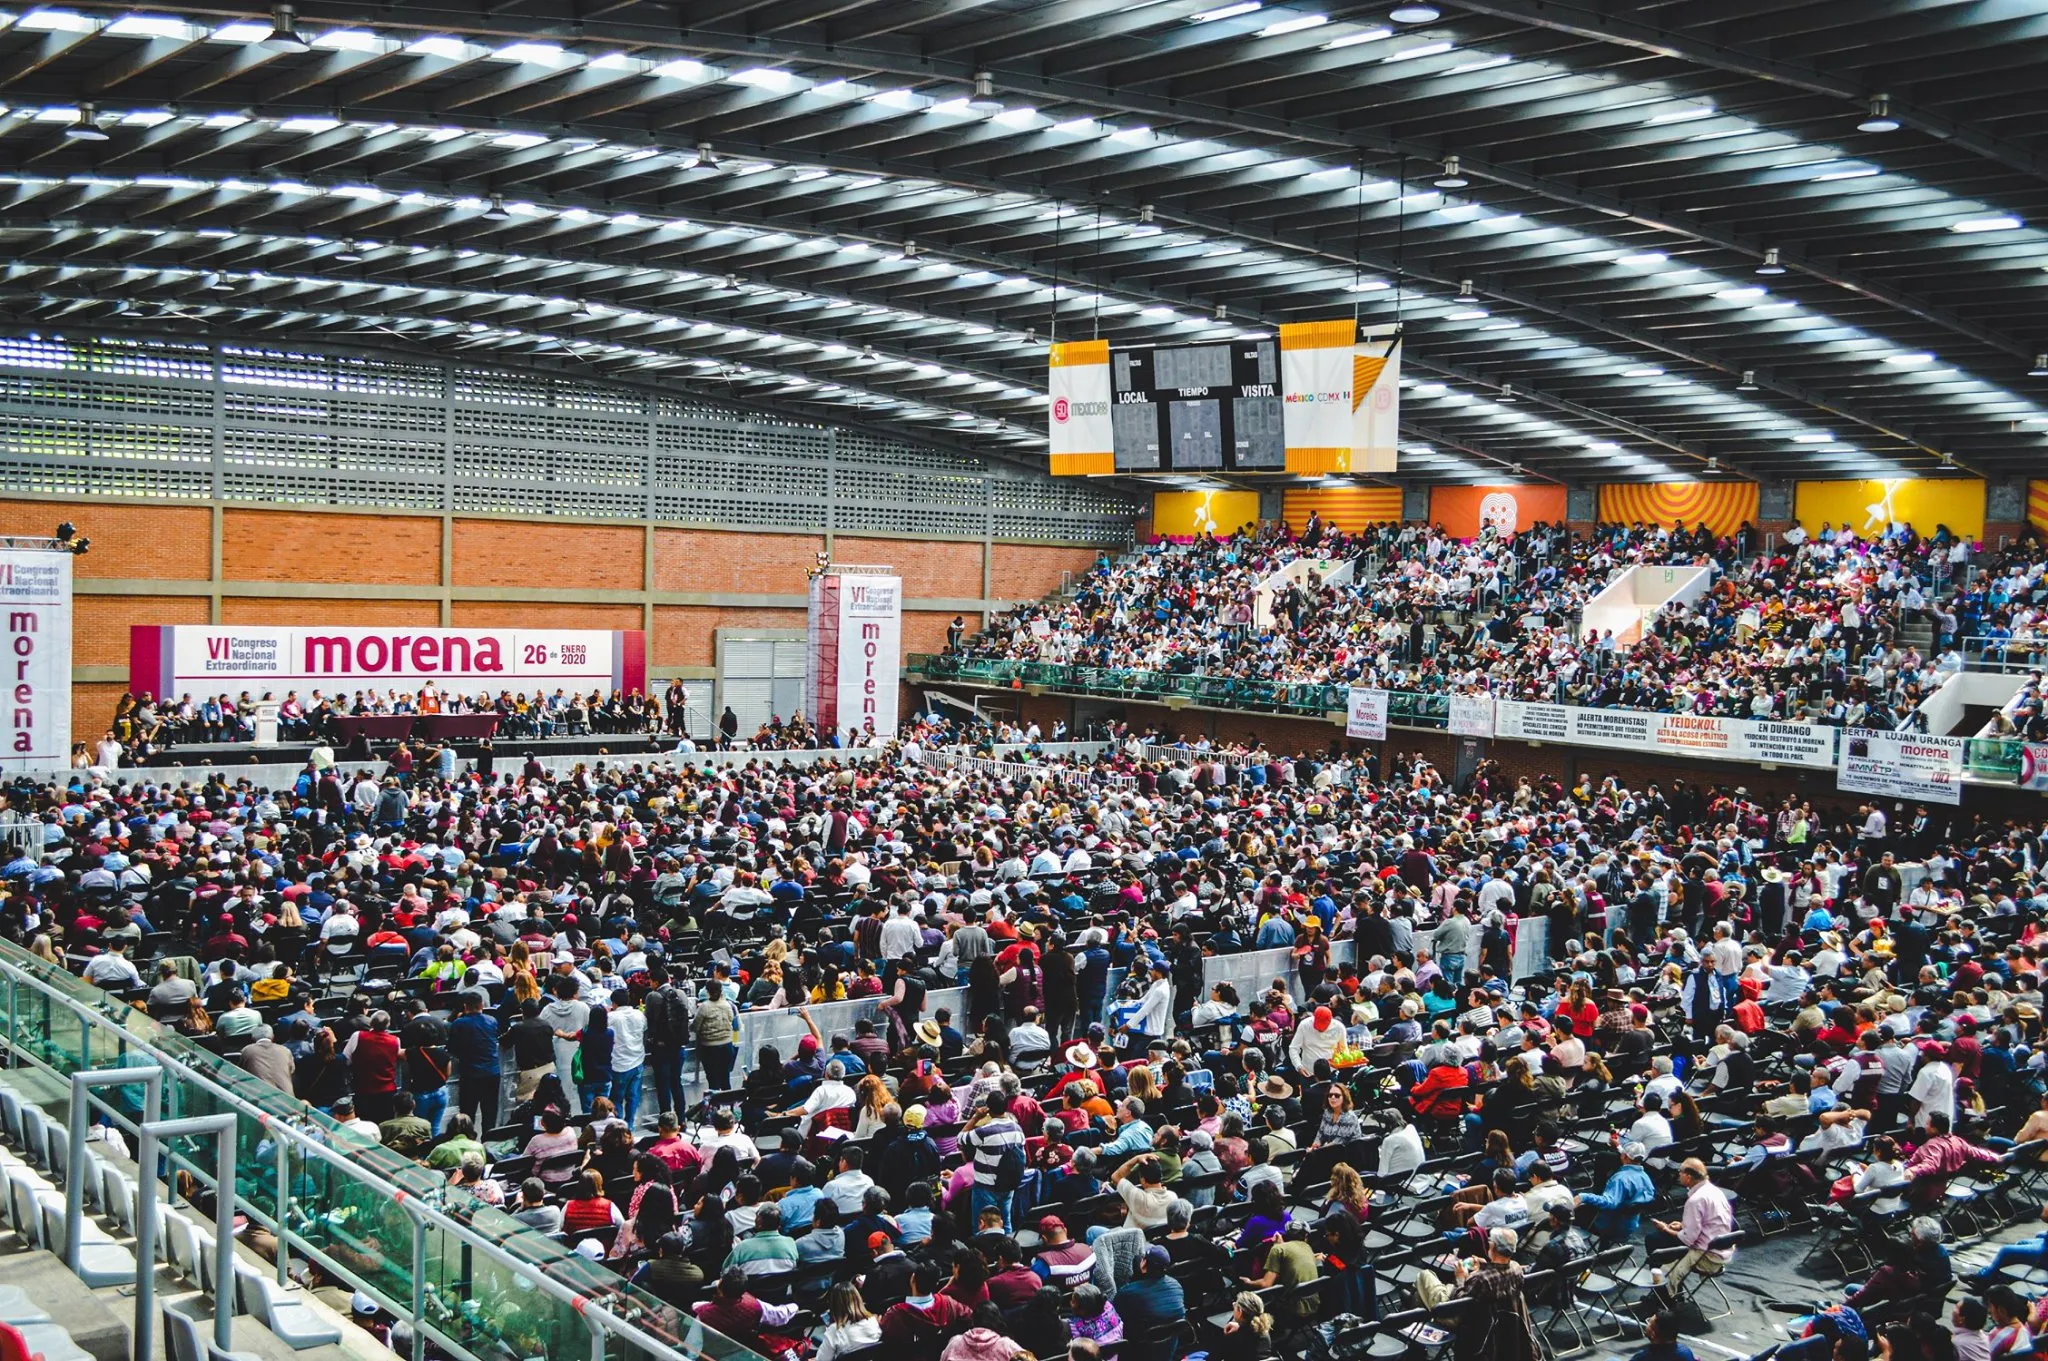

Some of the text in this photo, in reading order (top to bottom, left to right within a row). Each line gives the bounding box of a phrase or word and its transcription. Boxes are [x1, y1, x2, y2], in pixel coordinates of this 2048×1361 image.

[1118, 391, 1148, 404] LOCAL
[1178, 386, 1209, 397] TIEMPO
[1241, 384, 1275, 398] VISITA
[14, 564, 60, 577] Congreso
[15, 576, 58, 586] Nacional
[851, 586, 865, 602] VI
[207, 635, 587, 673] VI Congreso morena 26 de ENERO
[232, 649, 586, 665] Nacional 2020
[206, 660, 278, 671] Extraordinario
[9, 611, 39, 753] morena
[861, 622, 880, 734] morena
[1603, 715, 1648, 726] MORENISTAS!
[1670, 716, 1715, 731] YEIDCKOL
[1657, 728, 1671, 737] ALTO
[1671, 730, 1678, 738] AL
[1679, 730, 1699, 739] ACOSO
[1758, 723, 1811, 737] EN DURANGO
[1744, 733, 1769, 741] YEIDCKOL
[1803, 738, 1825, 746] MORENA
[1885, 731, 1917, 743] LUJAN
[1919, 735, 1962, 748] URANGA
[1769, 751, 1783, 759] TODO
[1786, 744, 1793, 752] ES
[1794, 745, 1818, 754] HACERLO
[1900, 744, 1949, 760] morena
[2034, 747, 2048, 759] CO
[1889, 779, 1920, 787] PRESIDENTA
